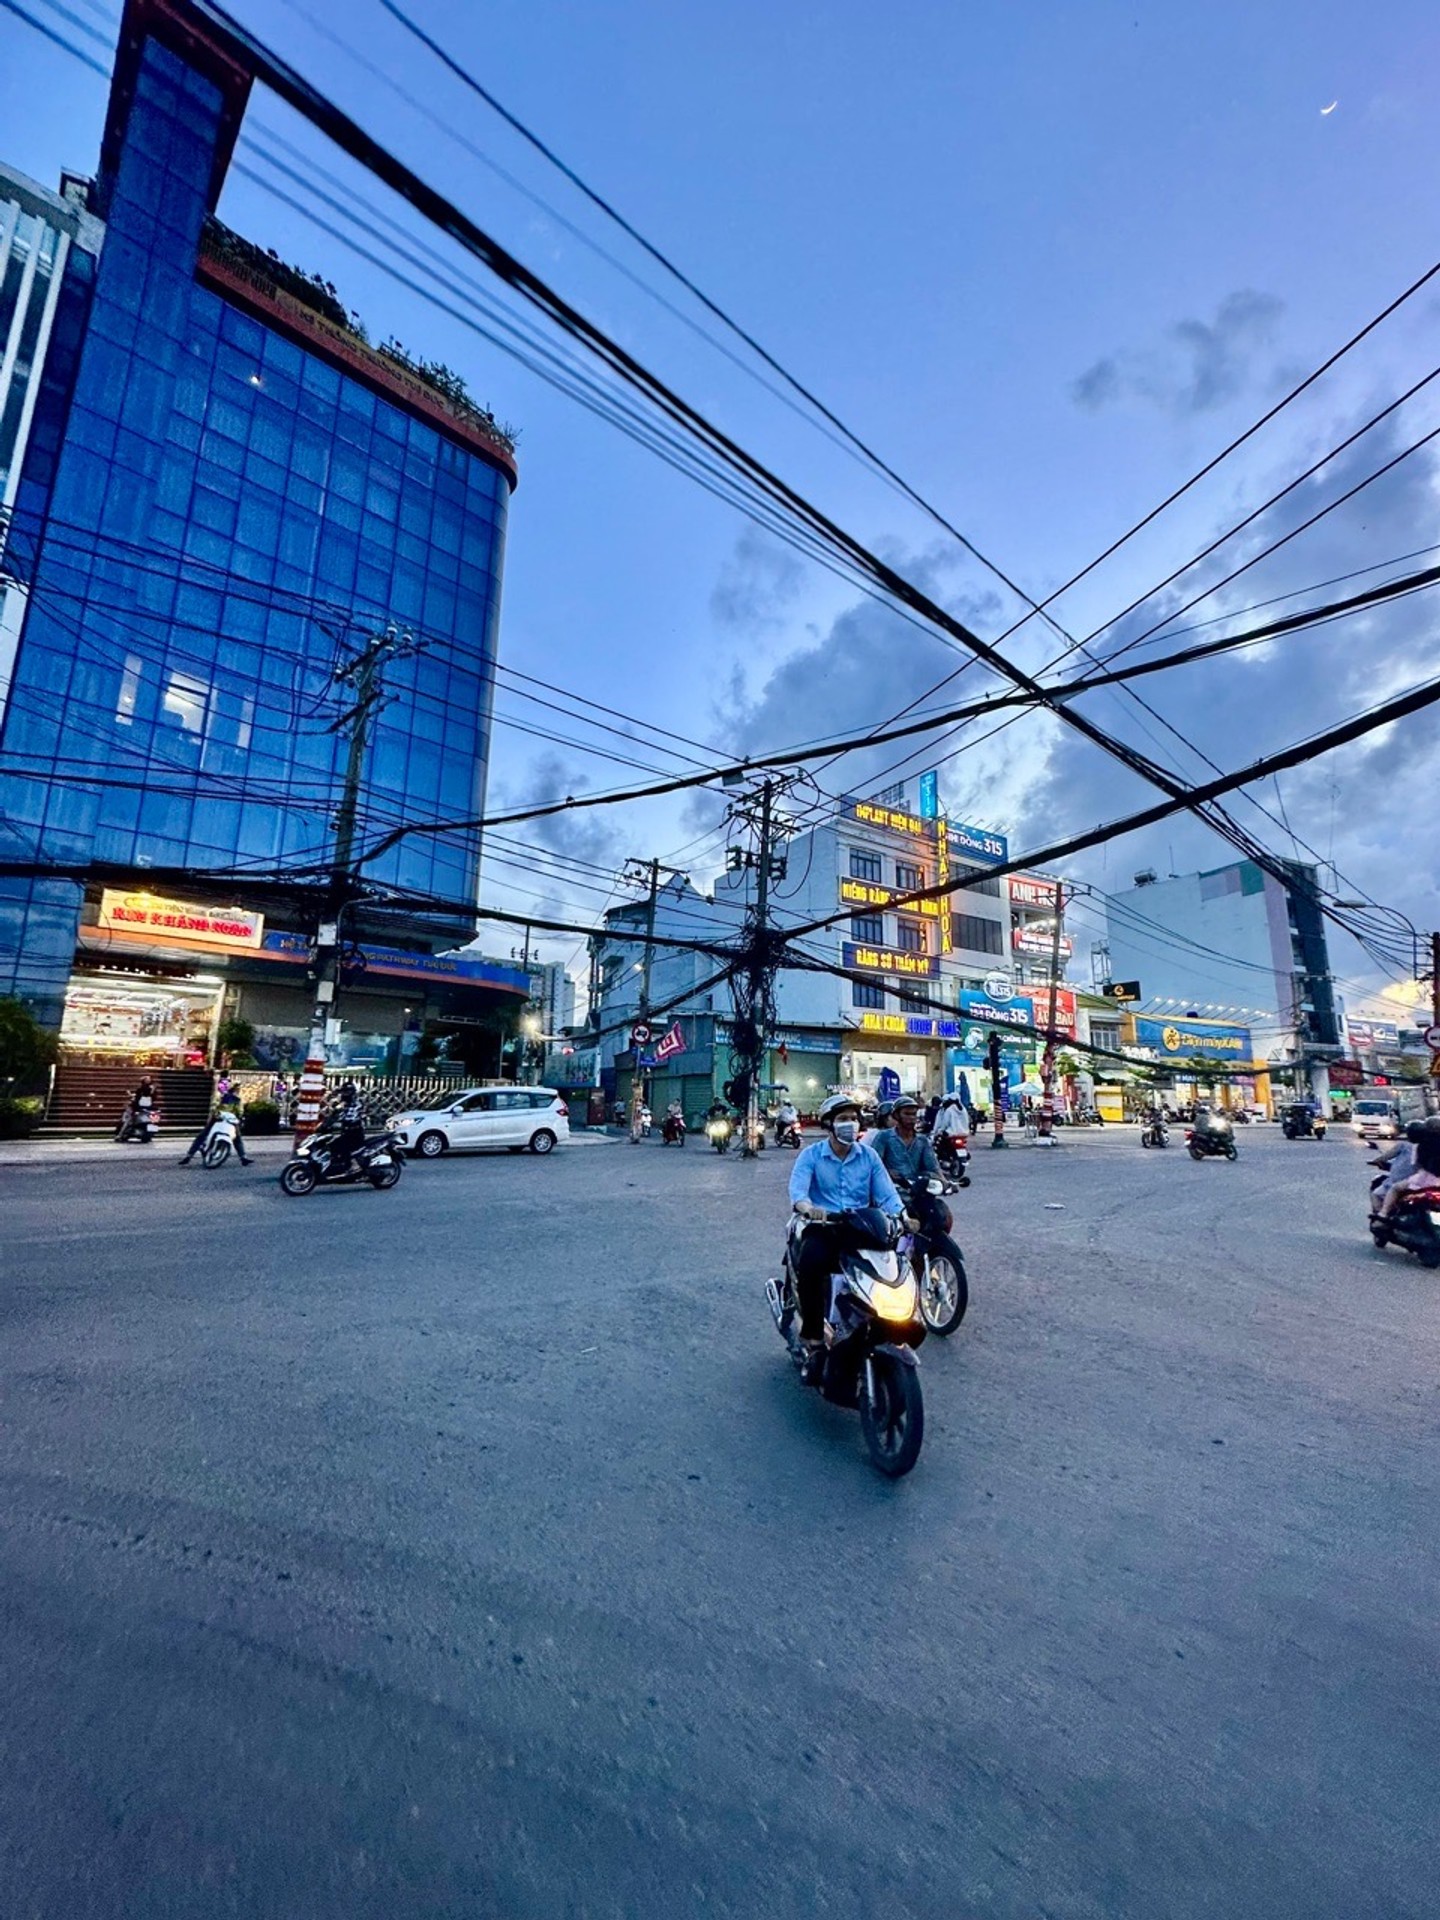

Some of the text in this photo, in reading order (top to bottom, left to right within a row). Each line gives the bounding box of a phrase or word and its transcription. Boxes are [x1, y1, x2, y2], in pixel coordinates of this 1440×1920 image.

[960, 832, 984, 851] ĐỒNG
[983, 838, 1003, 857] 315
[864, 1012, 882, 1031] NHA
[883, 1014, 906, 1033] KHOA
[1009, 1007, 1029, 1025] 315
